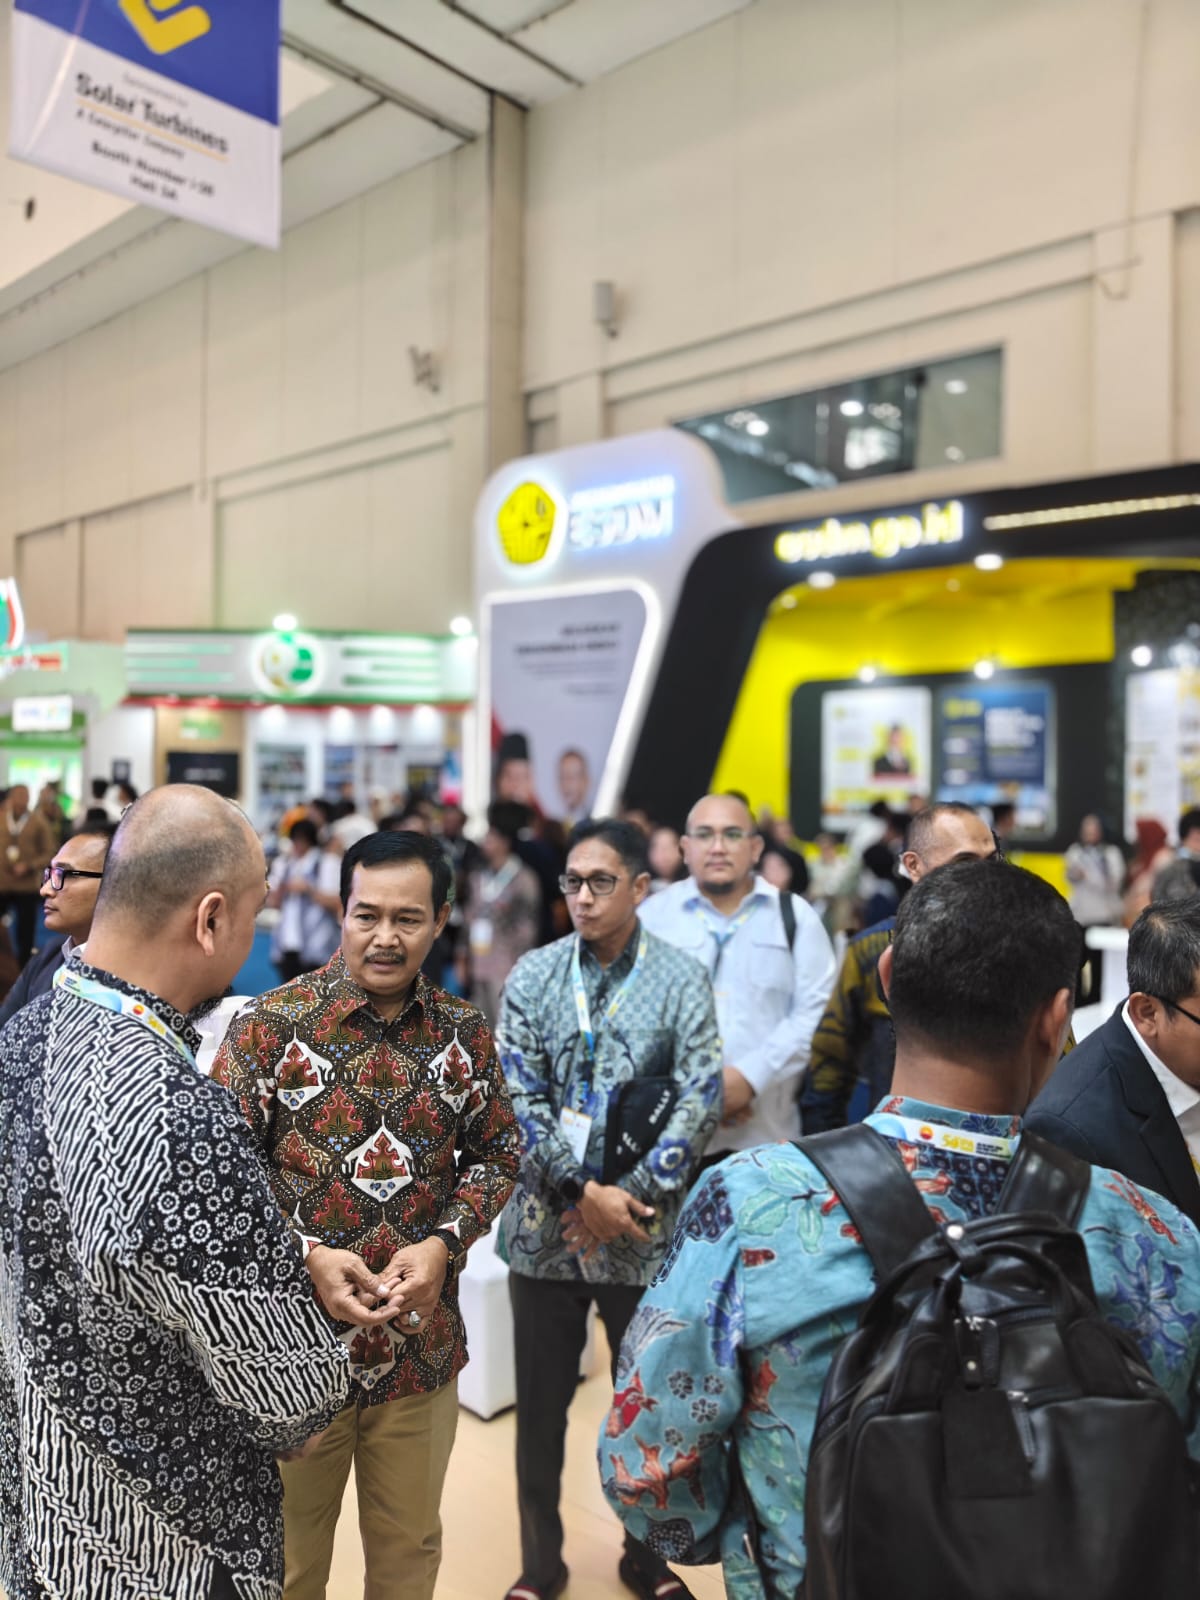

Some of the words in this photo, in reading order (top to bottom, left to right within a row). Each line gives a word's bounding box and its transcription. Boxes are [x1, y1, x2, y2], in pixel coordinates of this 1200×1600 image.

[76, 72, 134, 114] Solar
[143, 100, 229, 153] Turbines
[136, 157, 185, 185] Number
